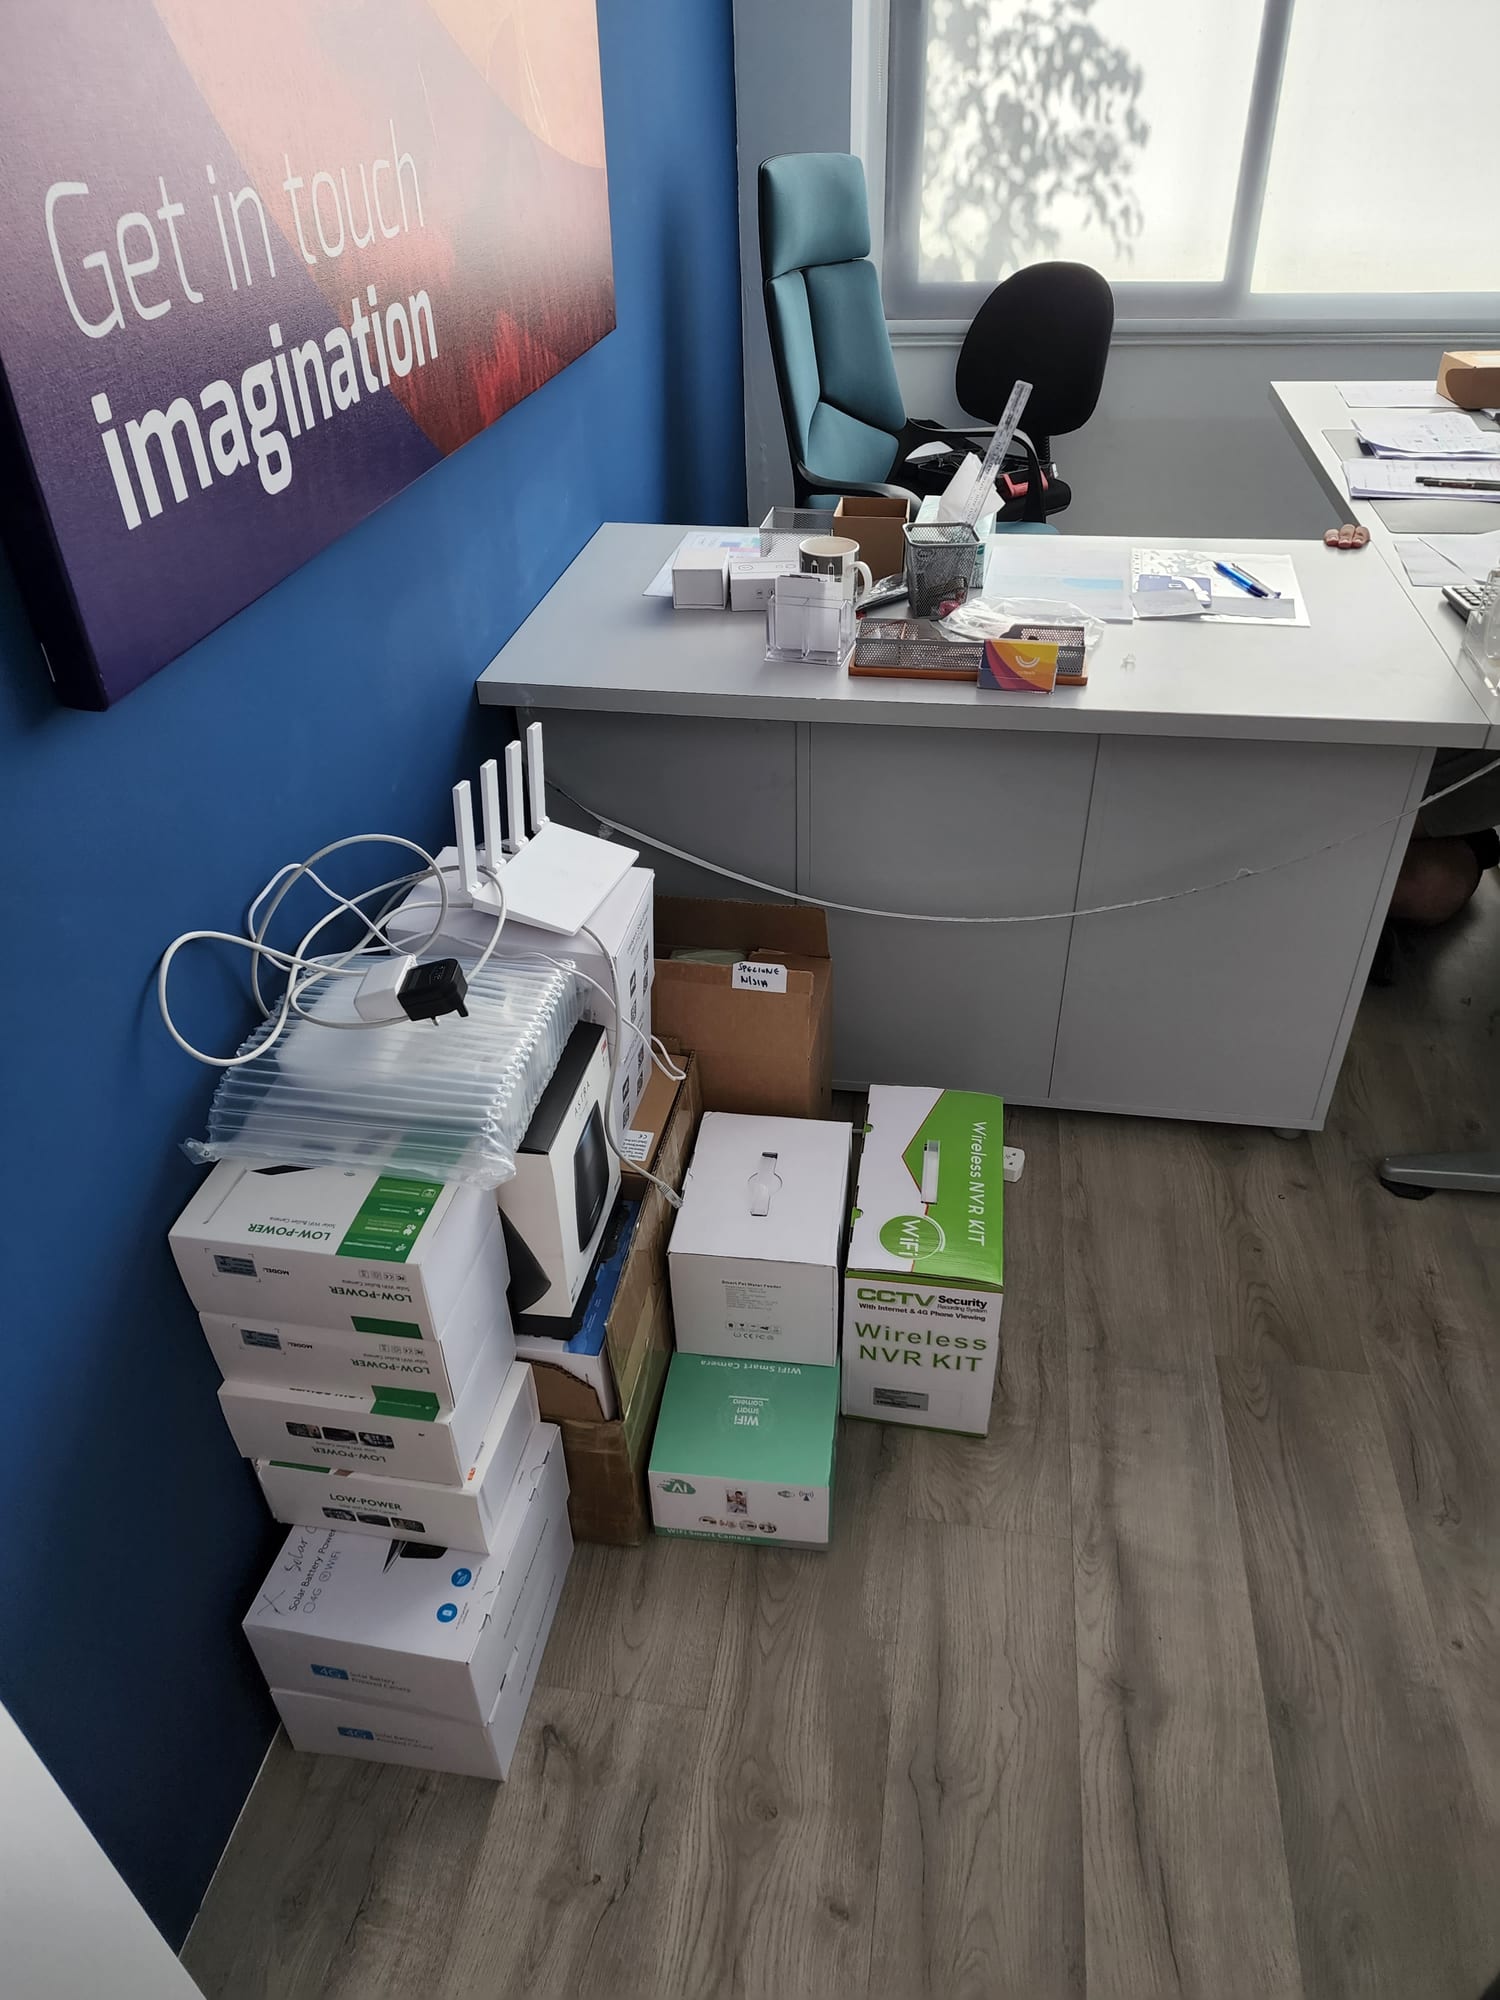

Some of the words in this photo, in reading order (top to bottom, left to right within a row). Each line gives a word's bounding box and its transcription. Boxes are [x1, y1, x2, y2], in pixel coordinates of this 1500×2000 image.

[45, 176, 204, 339] Get
[206, 165, 276, 291] in
[282, 119, 425, 265] touch
[91, 284, 438, 531] imagination
[969, 1121, 988, 1178] Wireless
[967, 1181, 985, 1215] NVR
[247, 1223, 331, 1242] LOW-POWER
[898, 1219, 921, 1257] WiFi
[967, 1218, 985, 1247] KIT
[328, 1286, 412, 1303] LOW-POWER
[857, 1288, 936, 1307] CCTV
[938, 1295, 988, 1309] Security
[859, 1302, 876, 1311] With
[878, 1304, 908, 1314] Internet
[917, 1308, 929, 1316] 4G
[930, 1310, 954, 1318] Phone
[955, 1313, 986, 1322] Viewing
[855, 1321, 987, 1351] Wireless
[350, 1358, 430, 1374] LOW-POWER
[700, 1359, 740, 1370] Camera
[744, 1362, 775, 1373] Smart
[859, 1344, 922, 1367] NVR
[933, 1353, 983, 1373] KIT
[732, 1398, 764, 1407] camera
[736, 1407, 759, 1415] smart
[734, 1415, 760, 1427] WiFi
[311, 1446, 386, 1463] LOW-POWER
[671, 1482, 688, 1493] AI
[329, 1493, 402, 1510] LOW-POWER
[718, 1532, 751, 1542] Camera
[288, 1588, 306, 1611] Solar
[301, 1556, 323, 1587] Battery
